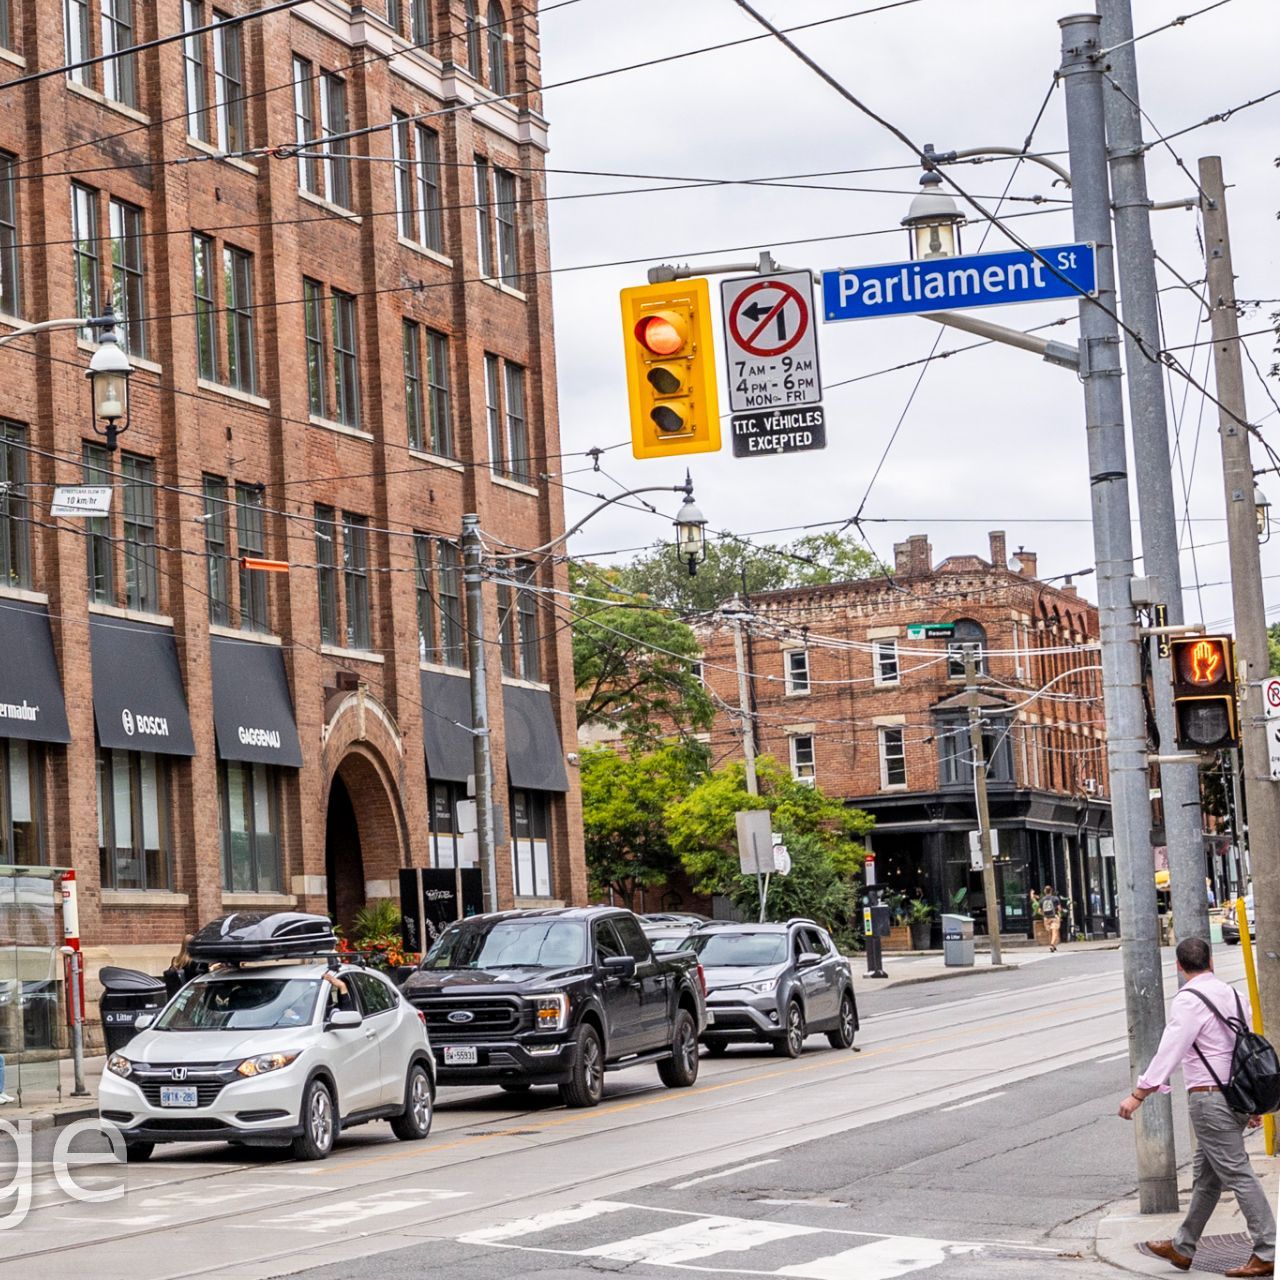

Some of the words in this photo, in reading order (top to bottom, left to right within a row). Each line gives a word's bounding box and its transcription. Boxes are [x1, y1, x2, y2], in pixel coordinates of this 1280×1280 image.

[839, 255, 1045, 308] Parliament
[1057, 251, 1077, 270] St
[745, 394, 772, 407] MON
[786, 390, 806, 402] FRI
[763, 411, 822, 431] VEHICLES
[748, 431, 812, 451] EXCEPTED
[67, 496, 75, 504] 10
[135, 714, 169, 737] BOSCH
[238, 726, 280, 748] GAGGENAU
[116, 1013, 133, 1022] Litter
